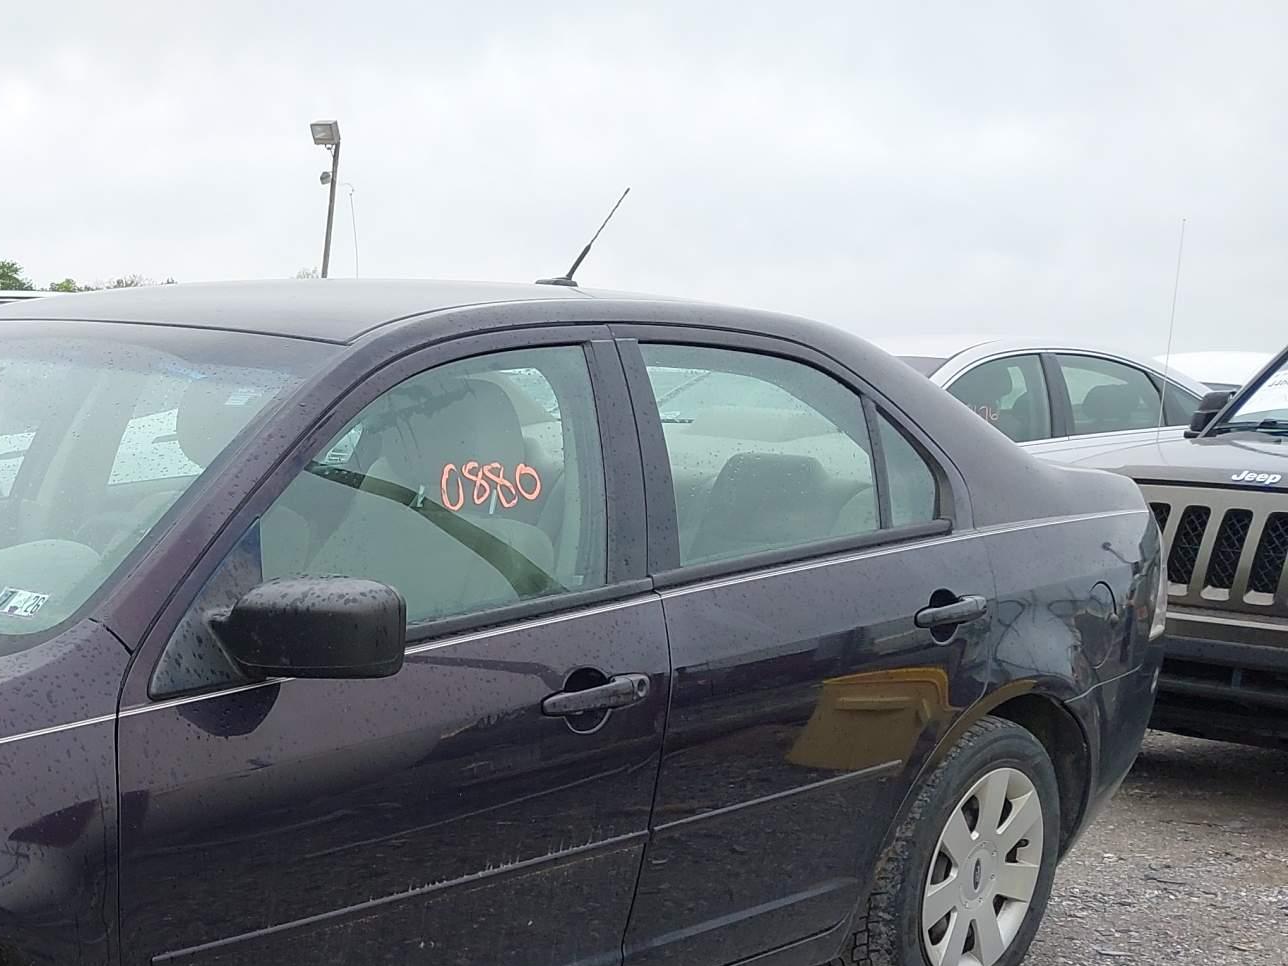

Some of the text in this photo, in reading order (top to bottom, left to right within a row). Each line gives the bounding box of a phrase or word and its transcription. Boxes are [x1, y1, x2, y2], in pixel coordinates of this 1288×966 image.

[440, 461, 542, 512] 0880
[1231, 470, 1282, 485] Jeep
[23, 595, 46, 614] 26
